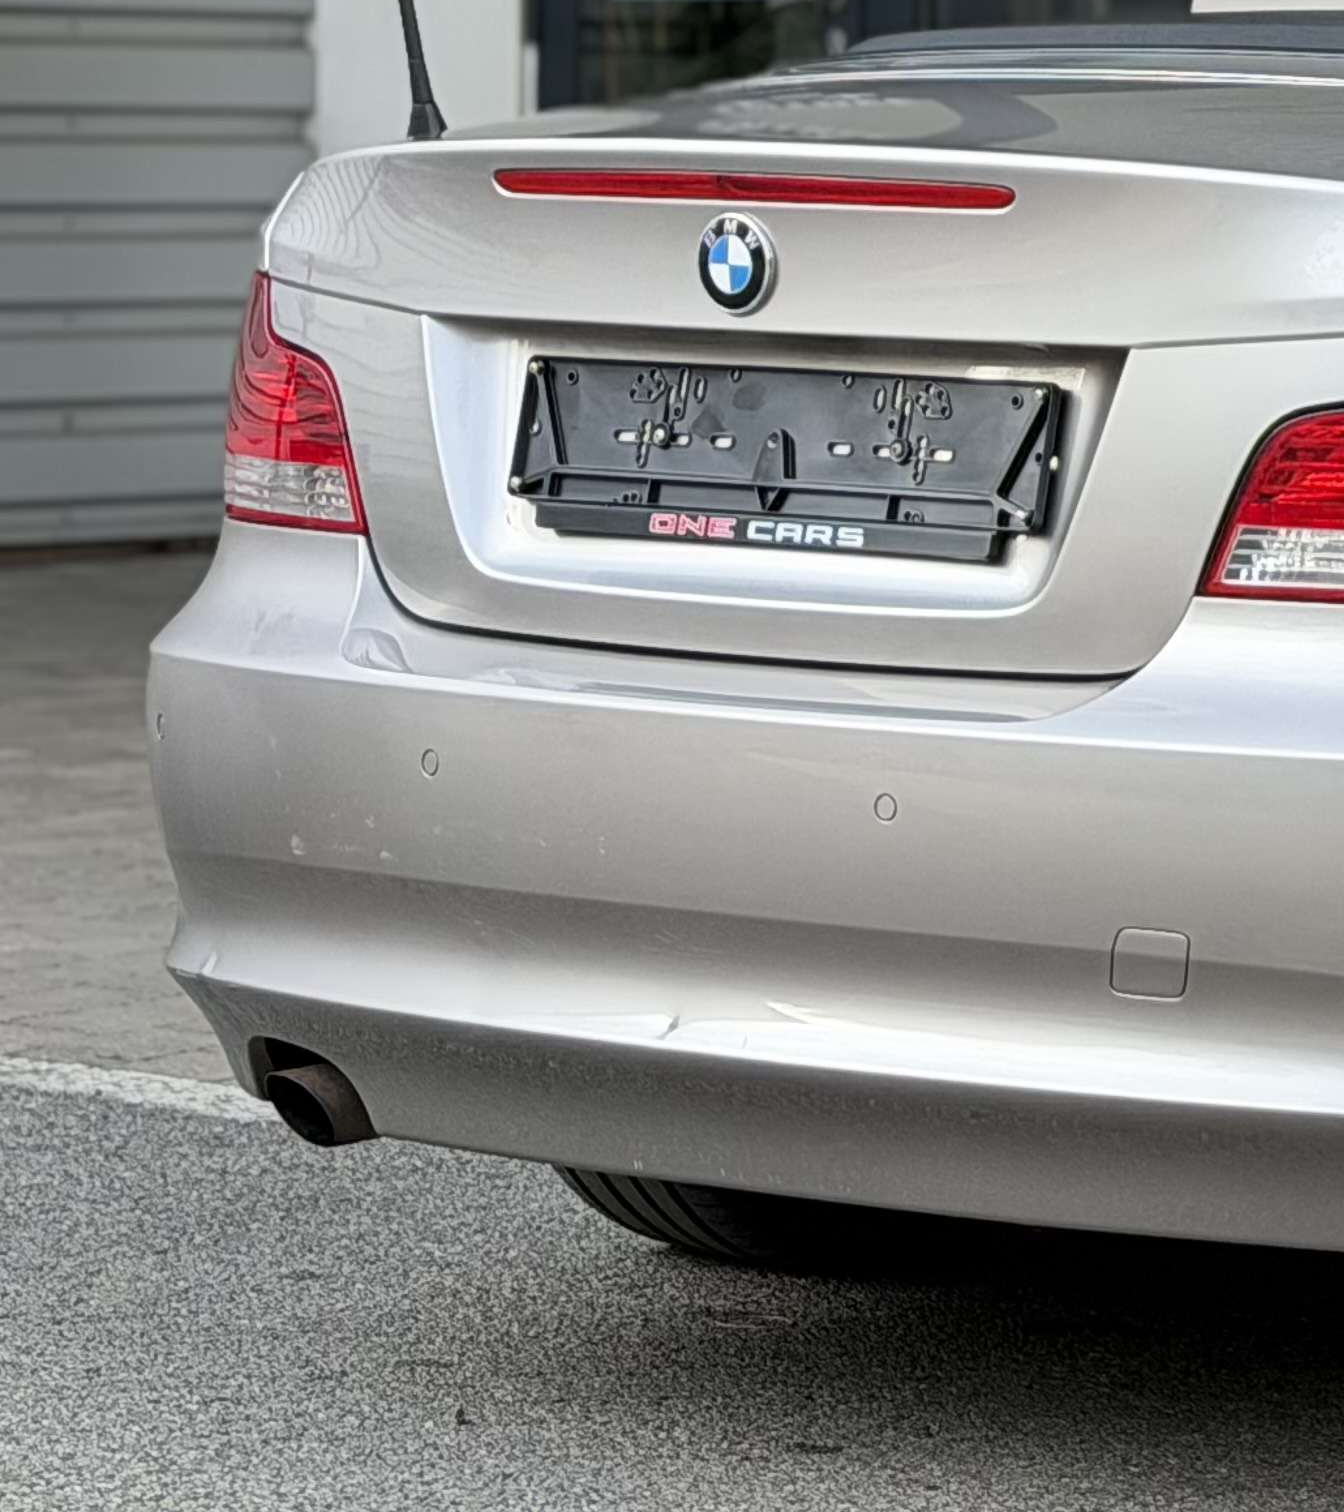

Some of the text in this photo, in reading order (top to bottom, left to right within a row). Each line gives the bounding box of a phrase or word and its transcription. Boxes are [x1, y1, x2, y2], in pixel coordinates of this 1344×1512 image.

[703, 218, 761, 250] BMW
[649, 512, 865, 548] ONE CARS
